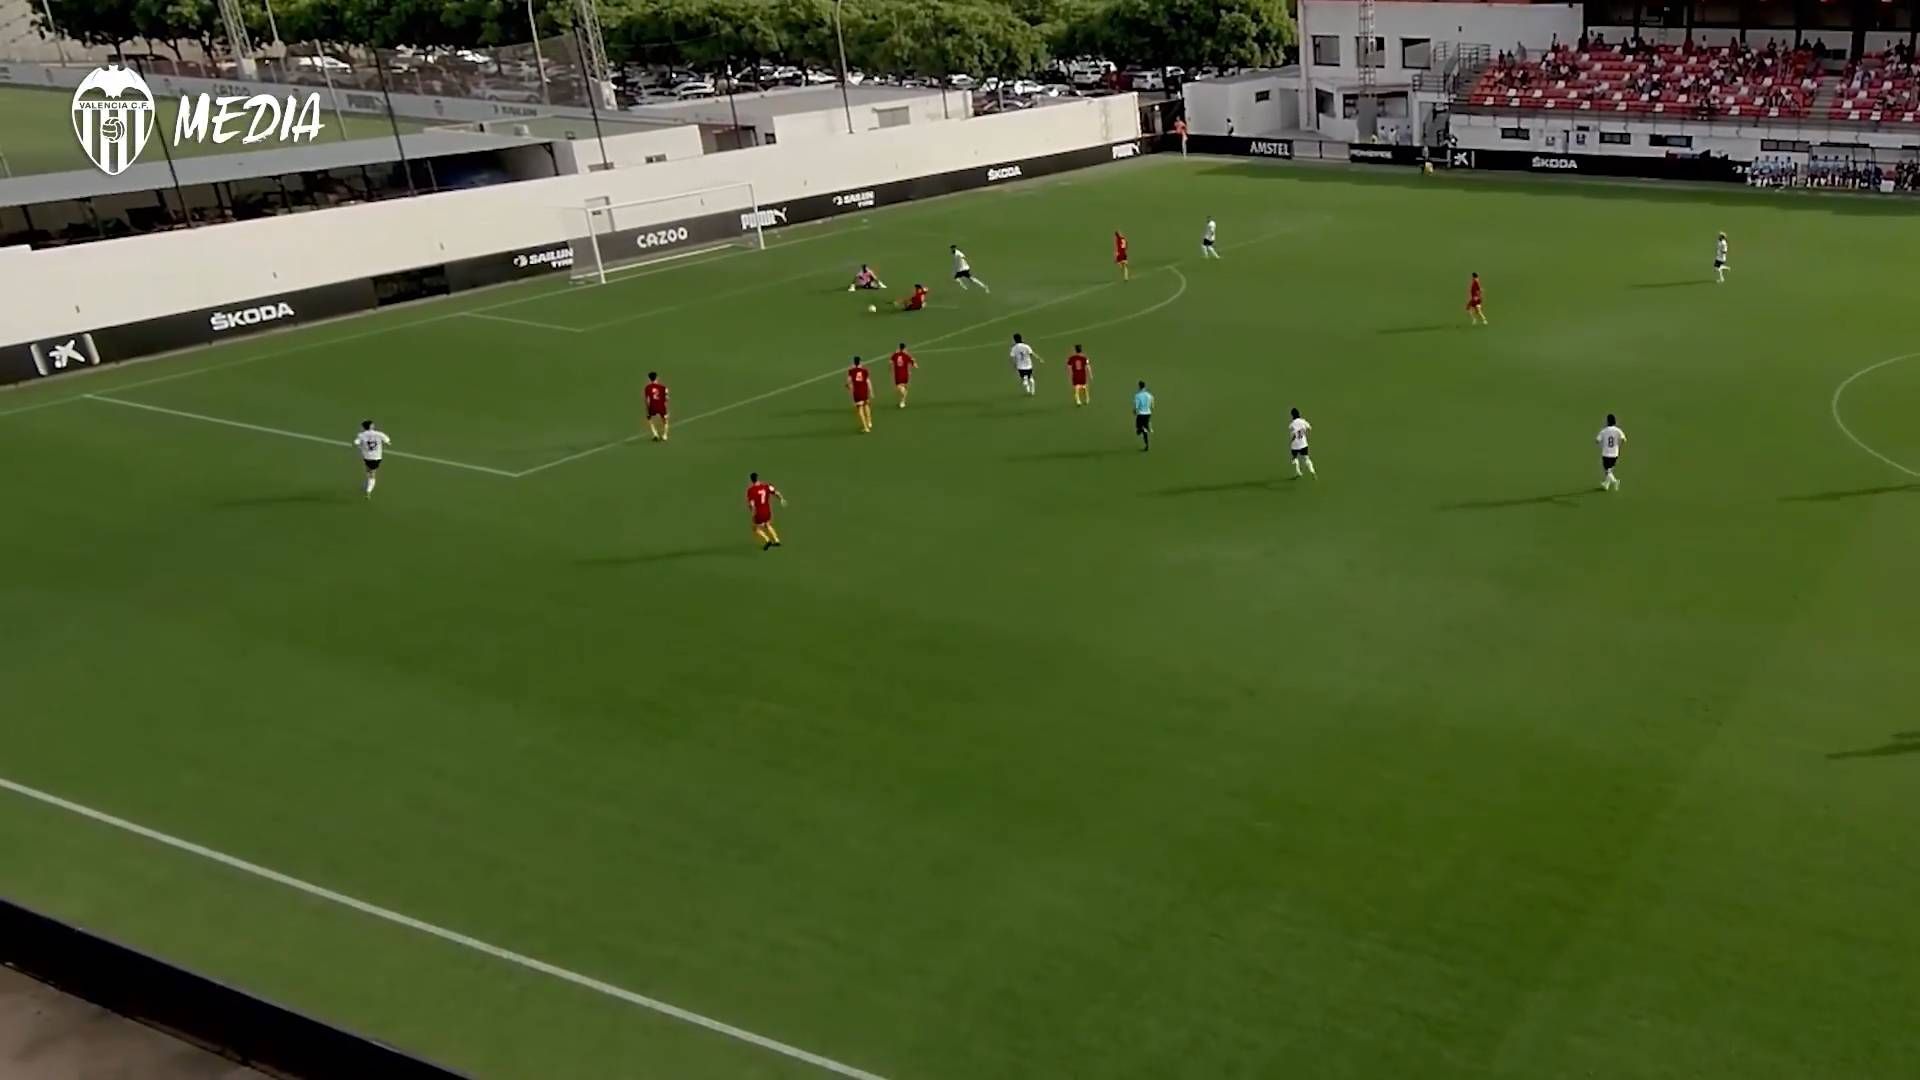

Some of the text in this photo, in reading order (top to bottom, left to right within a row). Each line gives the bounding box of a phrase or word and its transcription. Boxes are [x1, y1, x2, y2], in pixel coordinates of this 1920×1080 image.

[1250, 141, 1290, 156] AMSTEL
[637, 227, 688, 248] CAZOO
[210, 302, 295, 331] ŠKODA
[1608, 435, 1615, 448] 8
[758, 489, 767, 505] 7
